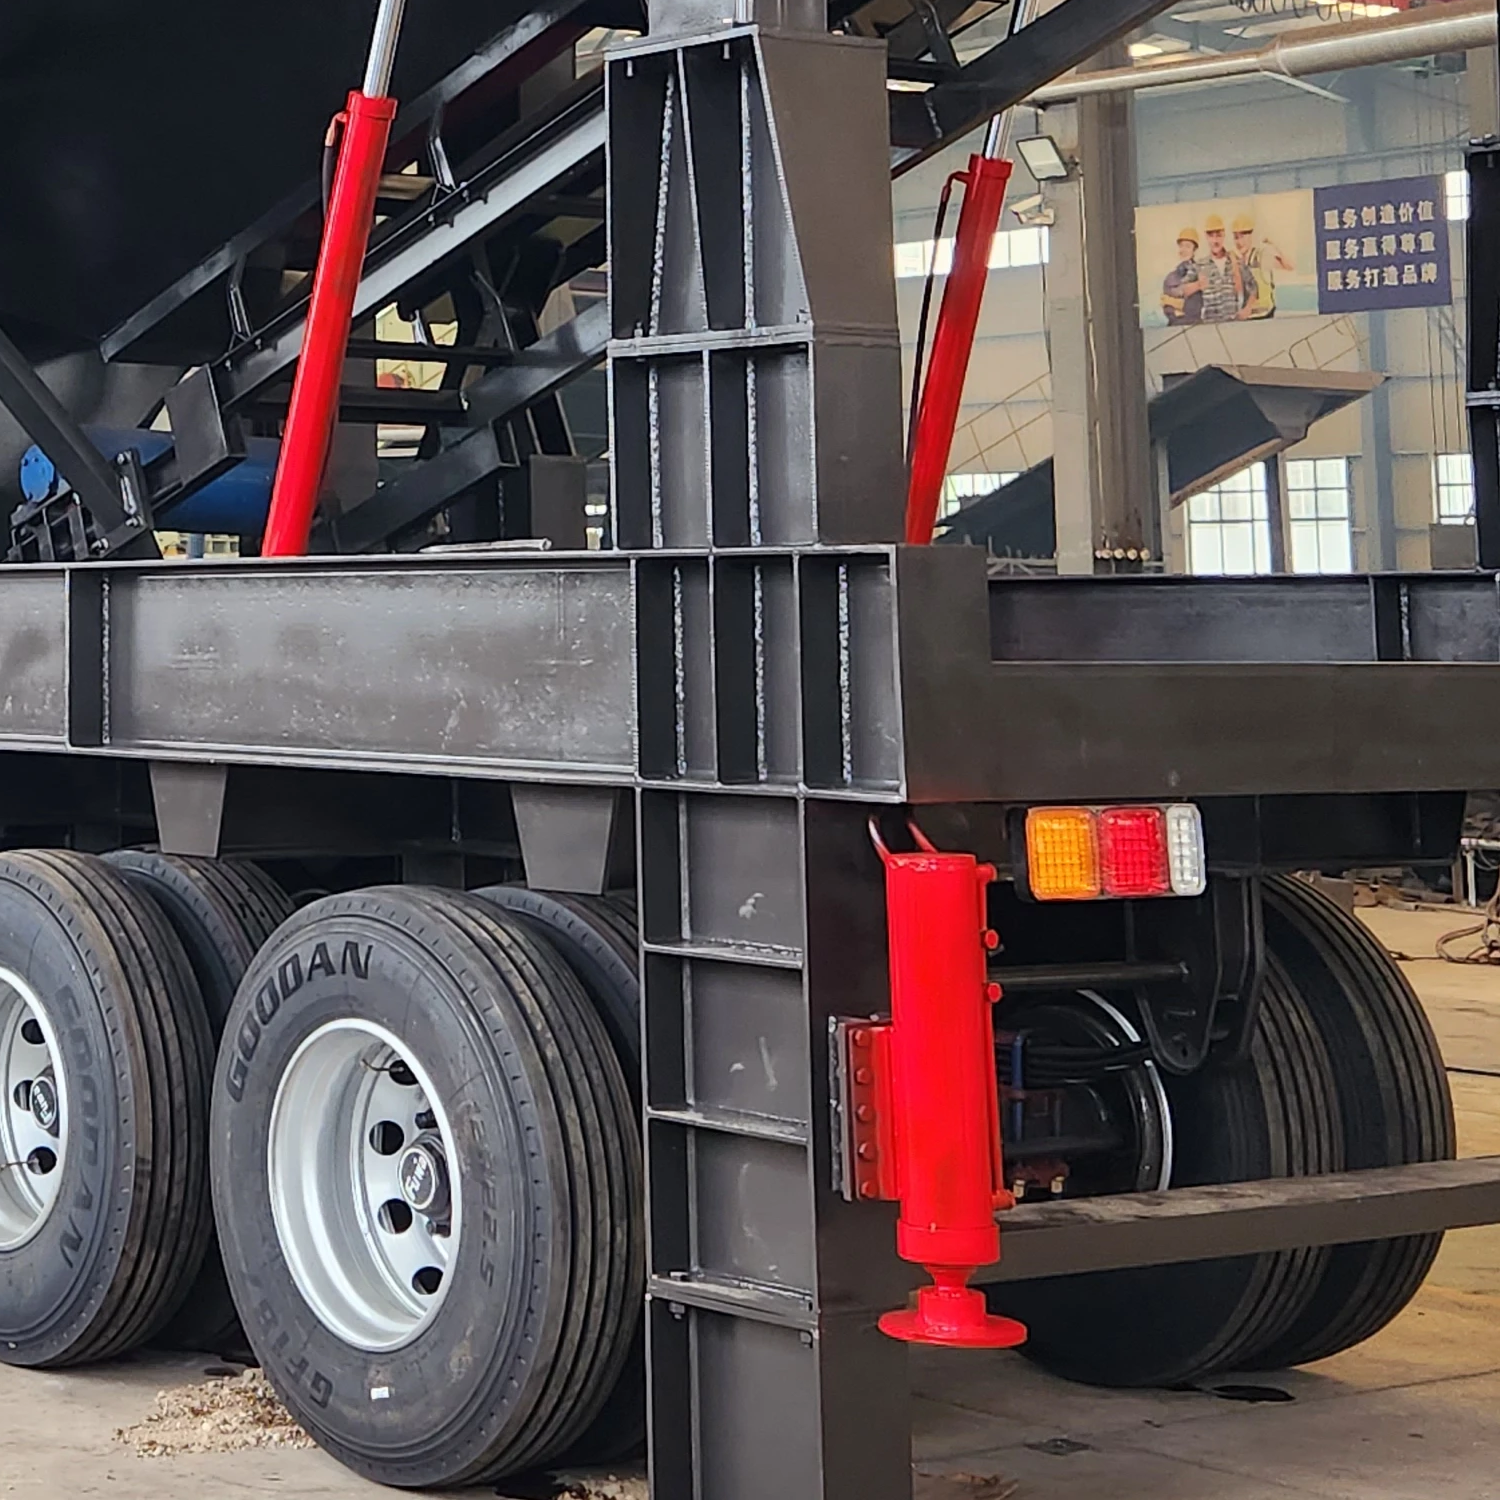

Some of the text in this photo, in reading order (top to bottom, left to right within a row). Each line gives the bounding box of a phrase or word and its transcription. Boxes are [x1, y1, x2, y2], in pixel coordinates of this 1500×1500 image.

[1323, 200, 1435, 230] 服务创造价值
[1327, 262, 1438, 292] 服务打造品牌
[225, 940, 374, 1103] GOODAN
